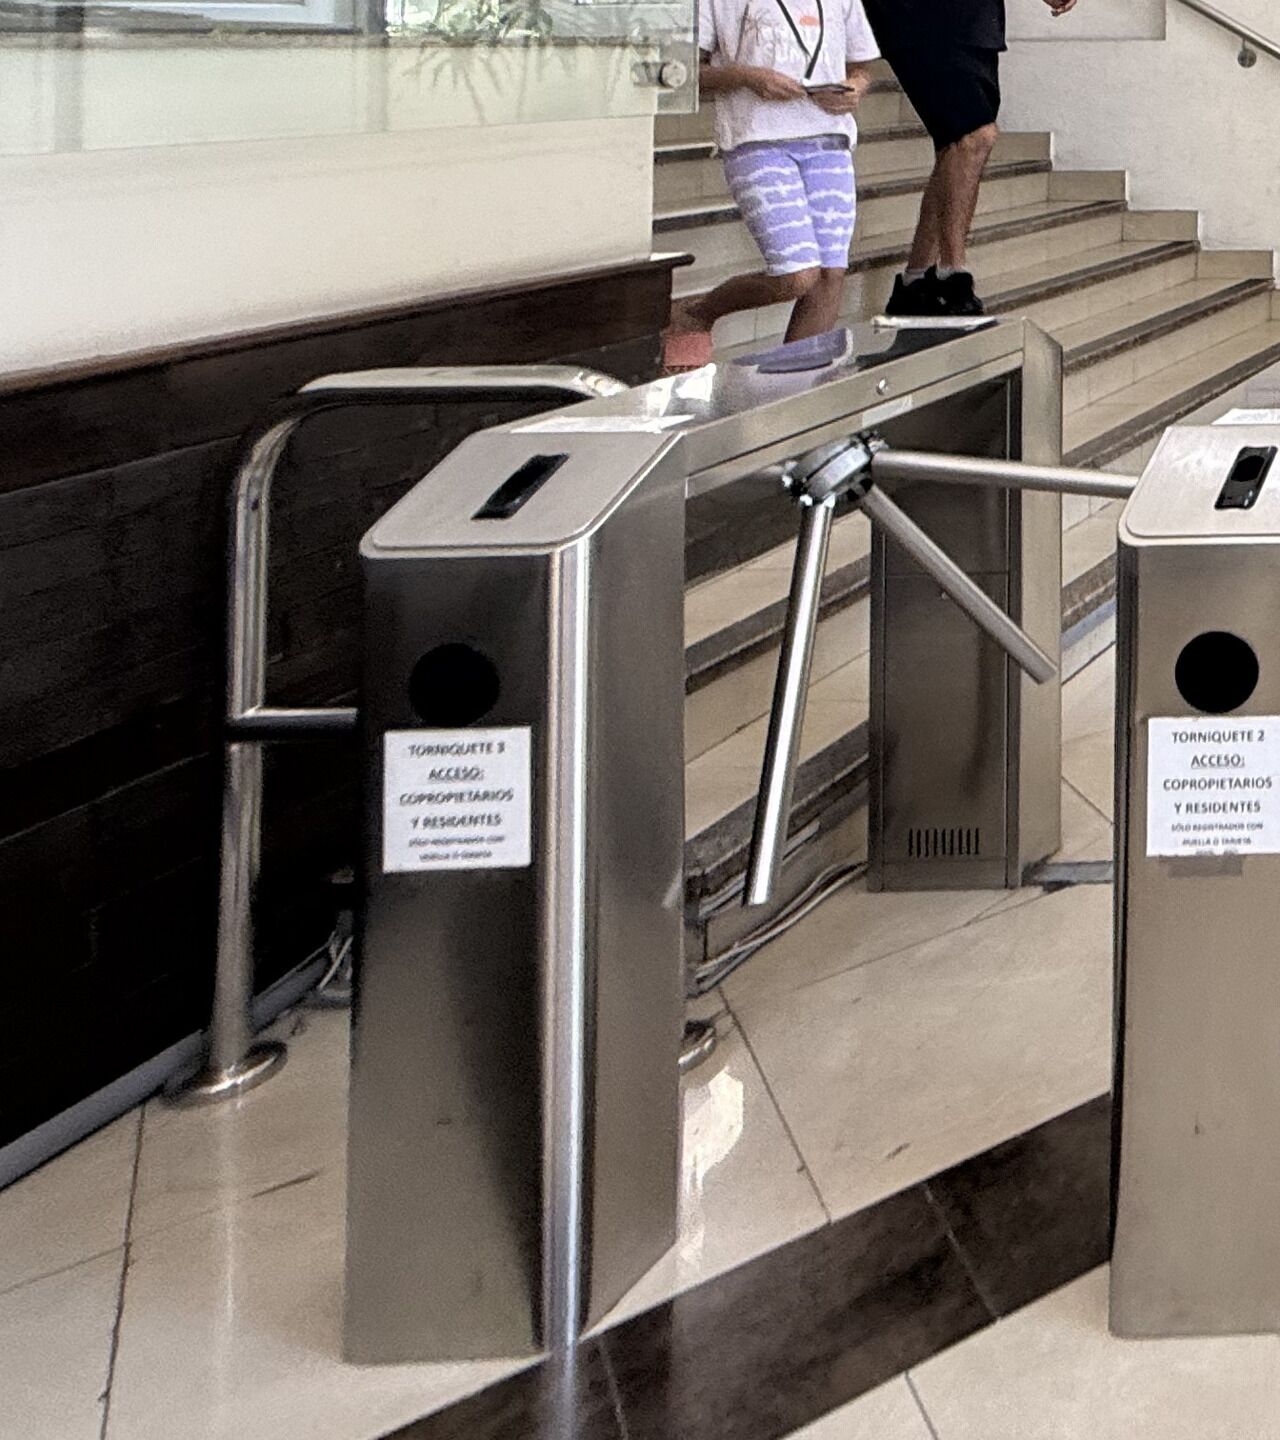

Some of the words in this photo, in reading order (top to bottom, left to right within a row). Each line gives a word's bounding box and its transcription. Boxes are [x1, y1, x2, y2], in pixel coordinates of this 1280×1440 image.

[1172, 730, 1254, 744] TORNIQUETE
[1257, 729, 1265, 742] 2
[408, 741, 493, 759] TORNIQUETE
[496, 741, 506, 754] 3
[1163, 776, 1273, 792] COPROPIETARIOS
[399, 788, 514, 807] COPROPIETARIOS
[1174, 803, 1182, 814] Y
[1186, 800, 1261, 814] RESIDENTES
[411, 816, 420, 829] Y
[422, 813, 503, 829] RESIDENTES
